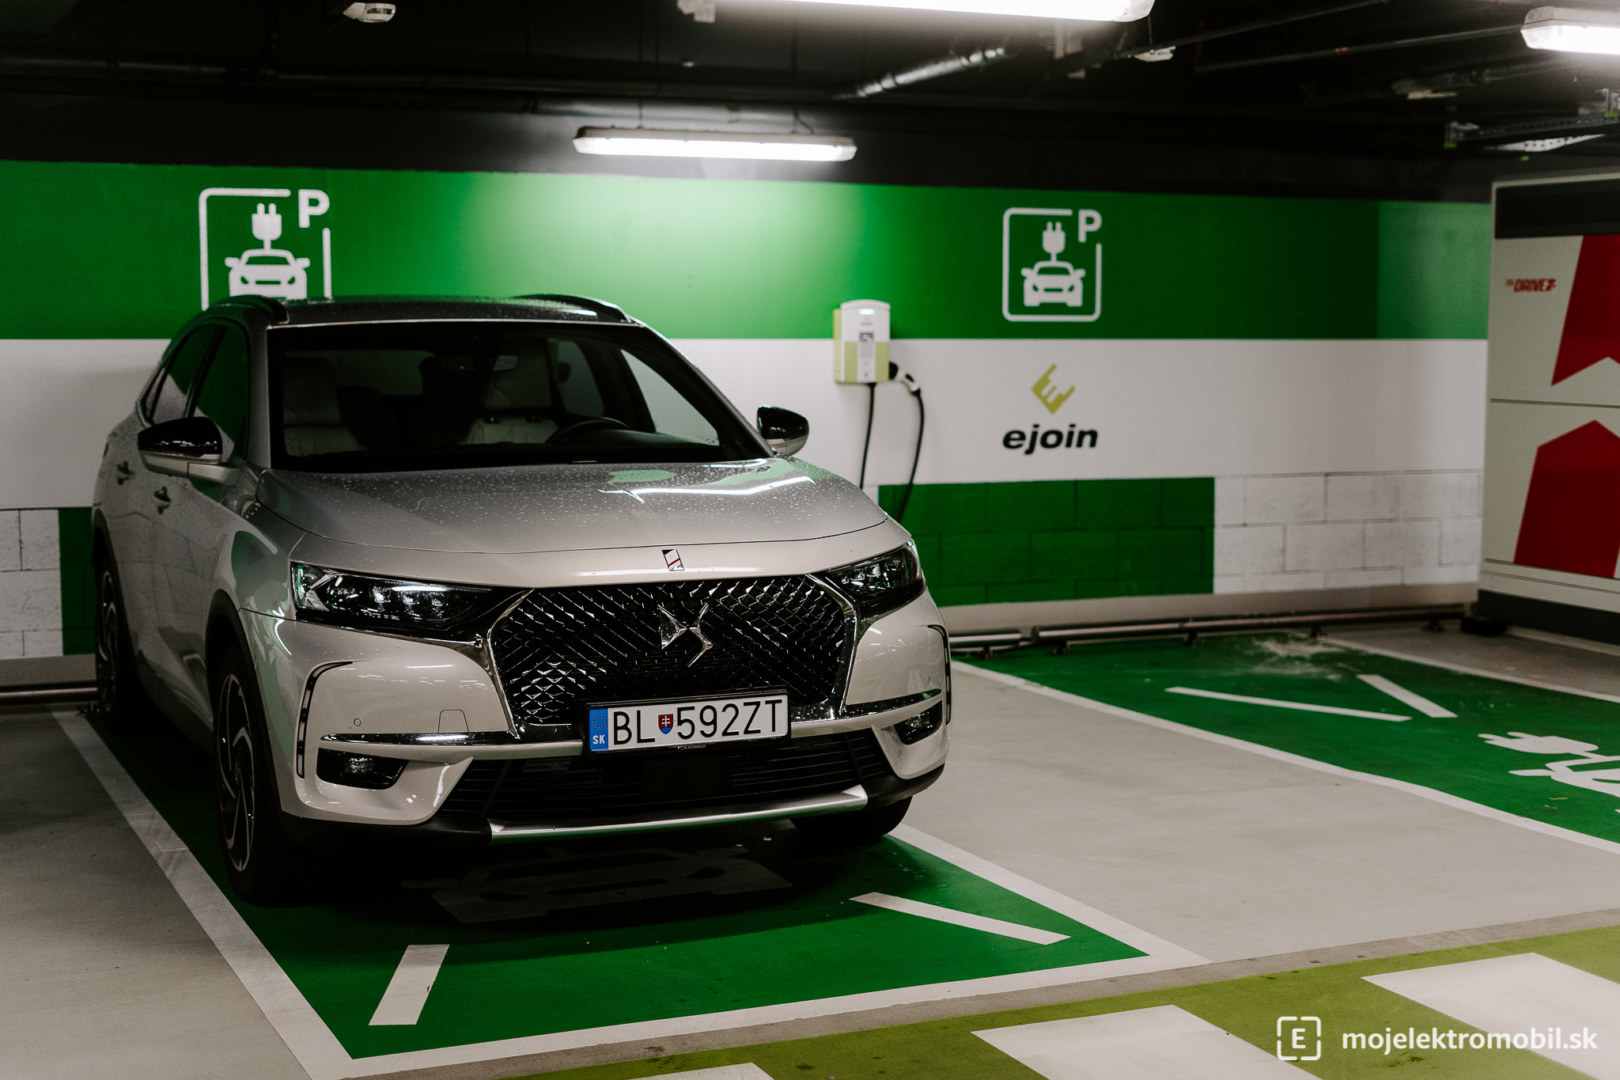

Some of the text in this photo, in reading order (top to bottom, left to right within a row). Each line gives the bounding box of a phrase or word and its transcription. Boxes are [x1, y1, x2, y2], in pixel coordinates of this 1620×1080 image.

[298, 189, 330, 228] P
[1078, 209, 1102, 243] P
[1002, 423, 1098, 455] ejoin
[613, 699, 783, 745] BL 592ZT
[592, 734, 606, 745] SK
